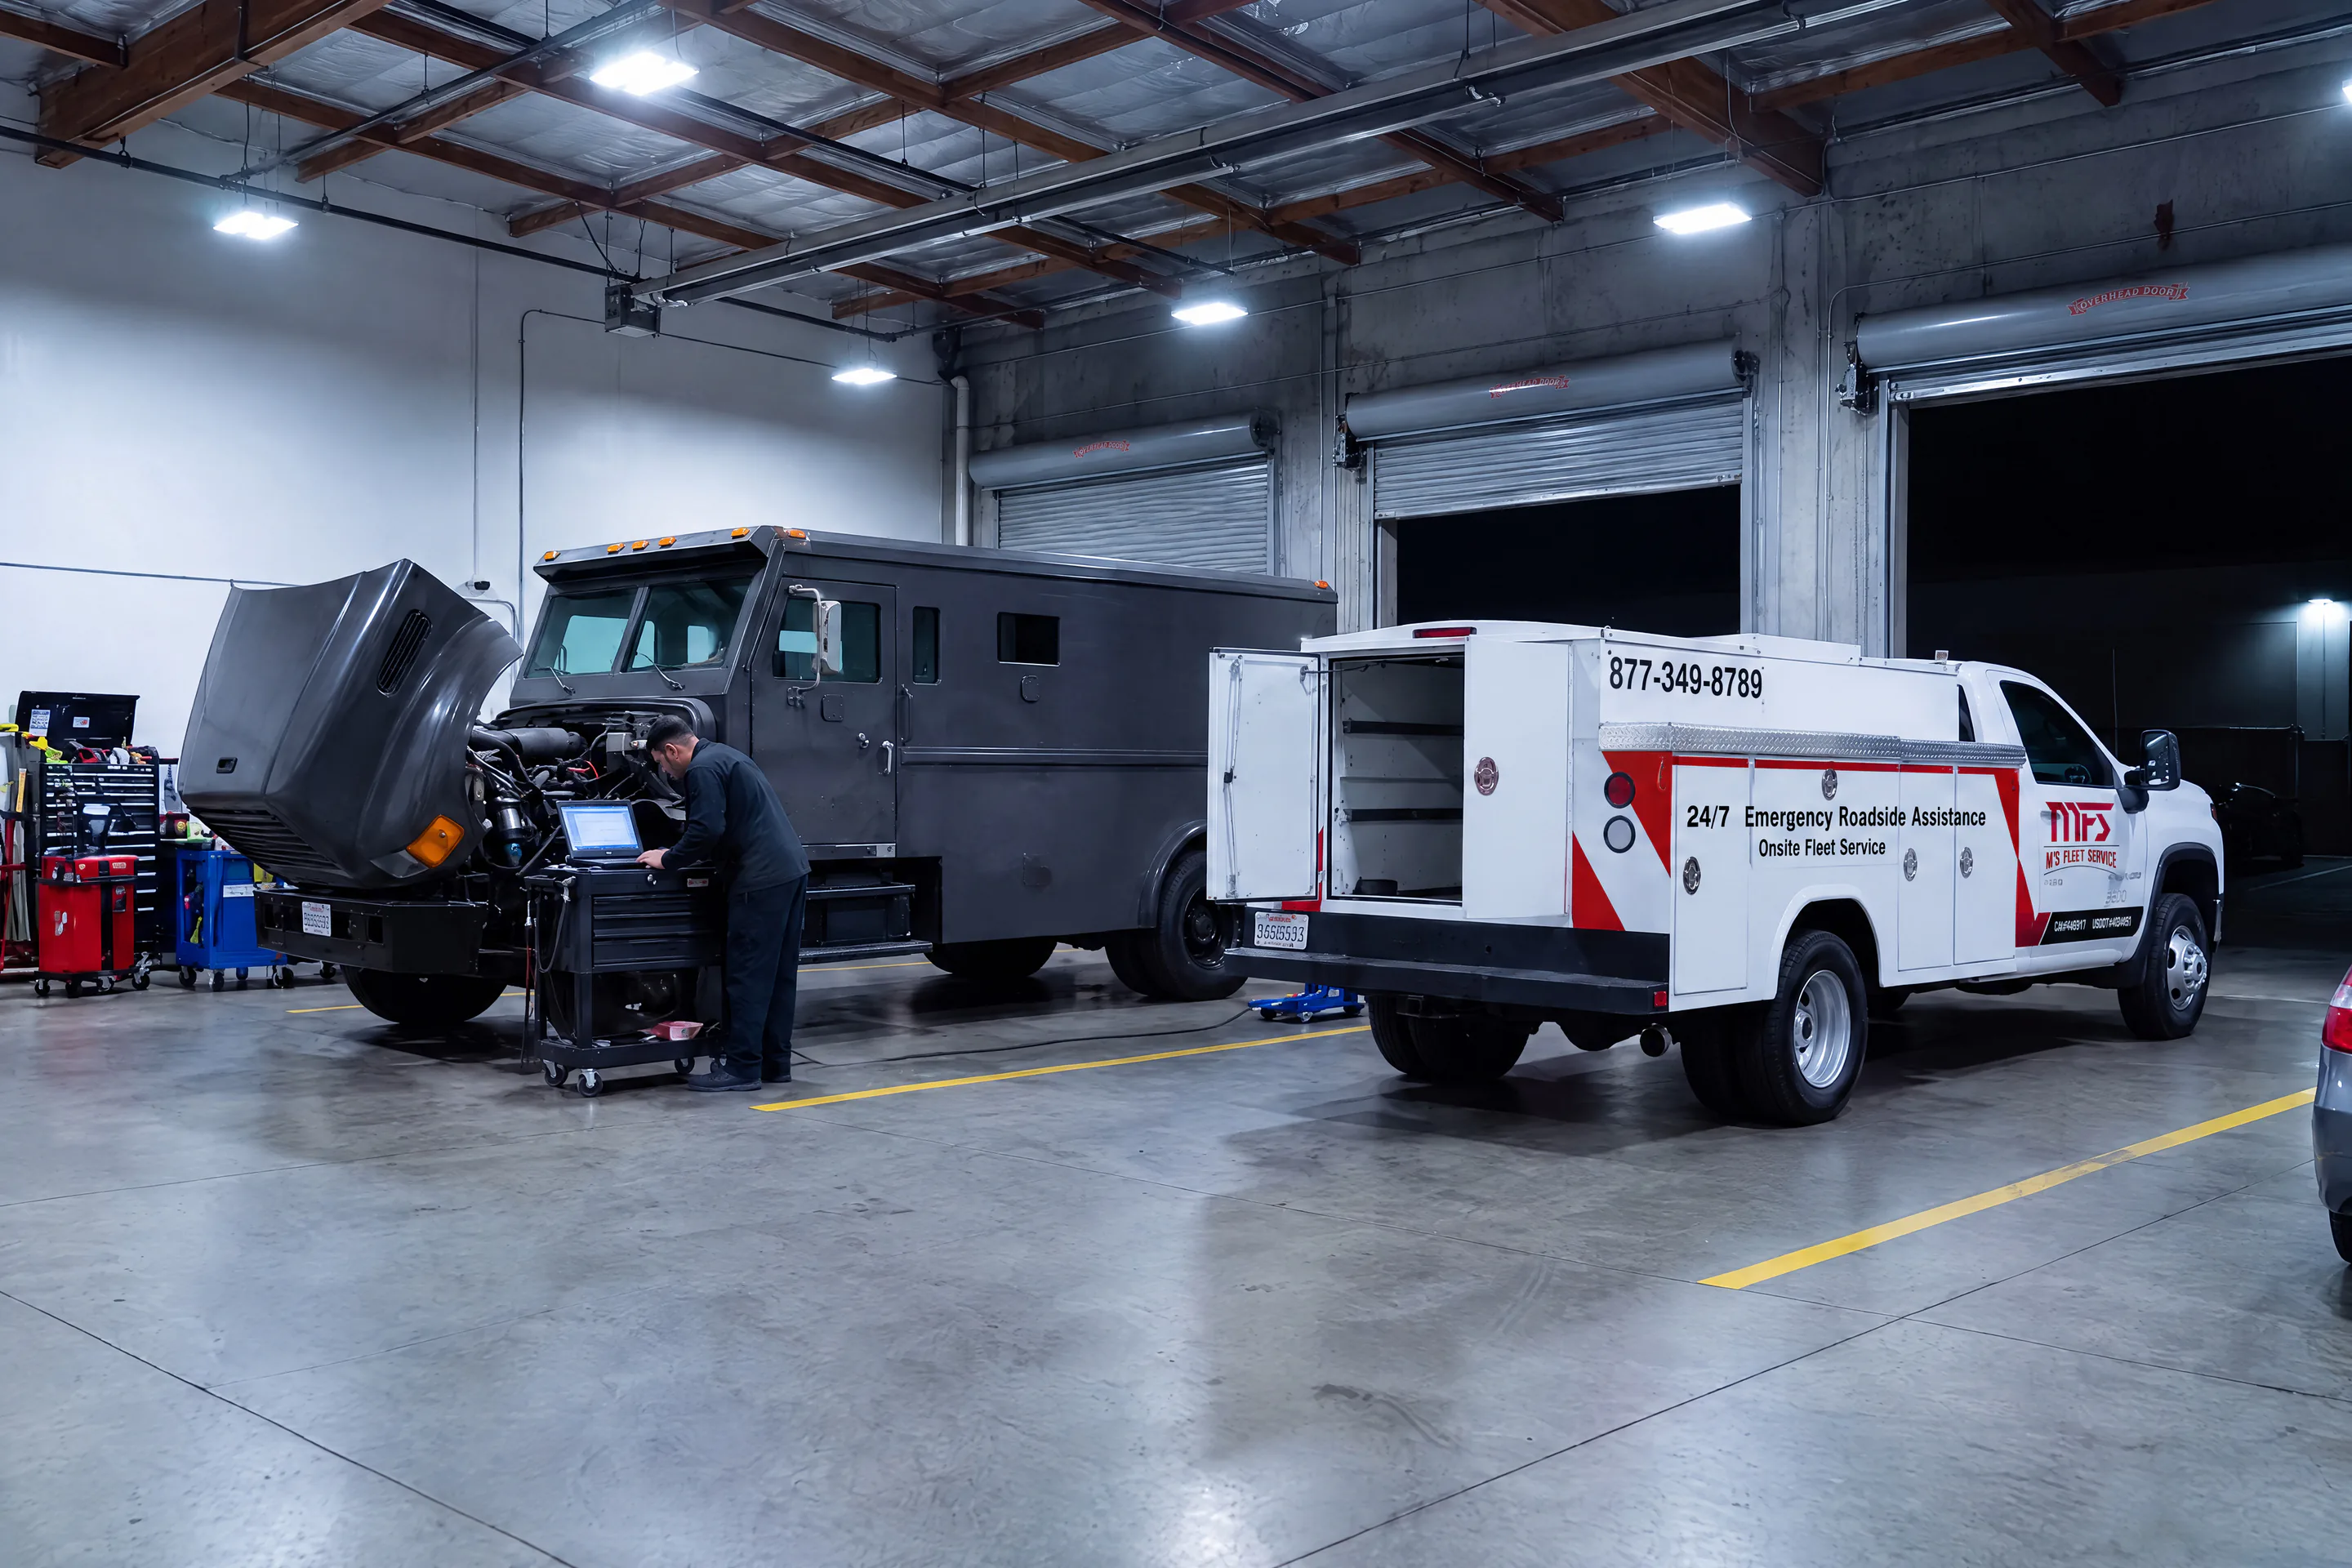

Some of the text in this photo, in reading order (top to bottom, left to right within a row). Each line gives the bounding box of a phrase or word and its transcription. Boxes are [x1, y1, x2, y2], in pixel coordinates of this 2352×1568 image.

[2080, 287, 2174, 309] OVERHEAD DOOR
[1610, 657, 1762, 699] 877-349-8789
[1686, 804, 1986, 831] 24/7 Emergency Roadside Assistance
[2045, 801, 2114, 842] MFS
[1759, 838, 1886, 857] Onsite Fleet Service
[2046, 849, 2117, 870] M'S FLEET SERVICE
